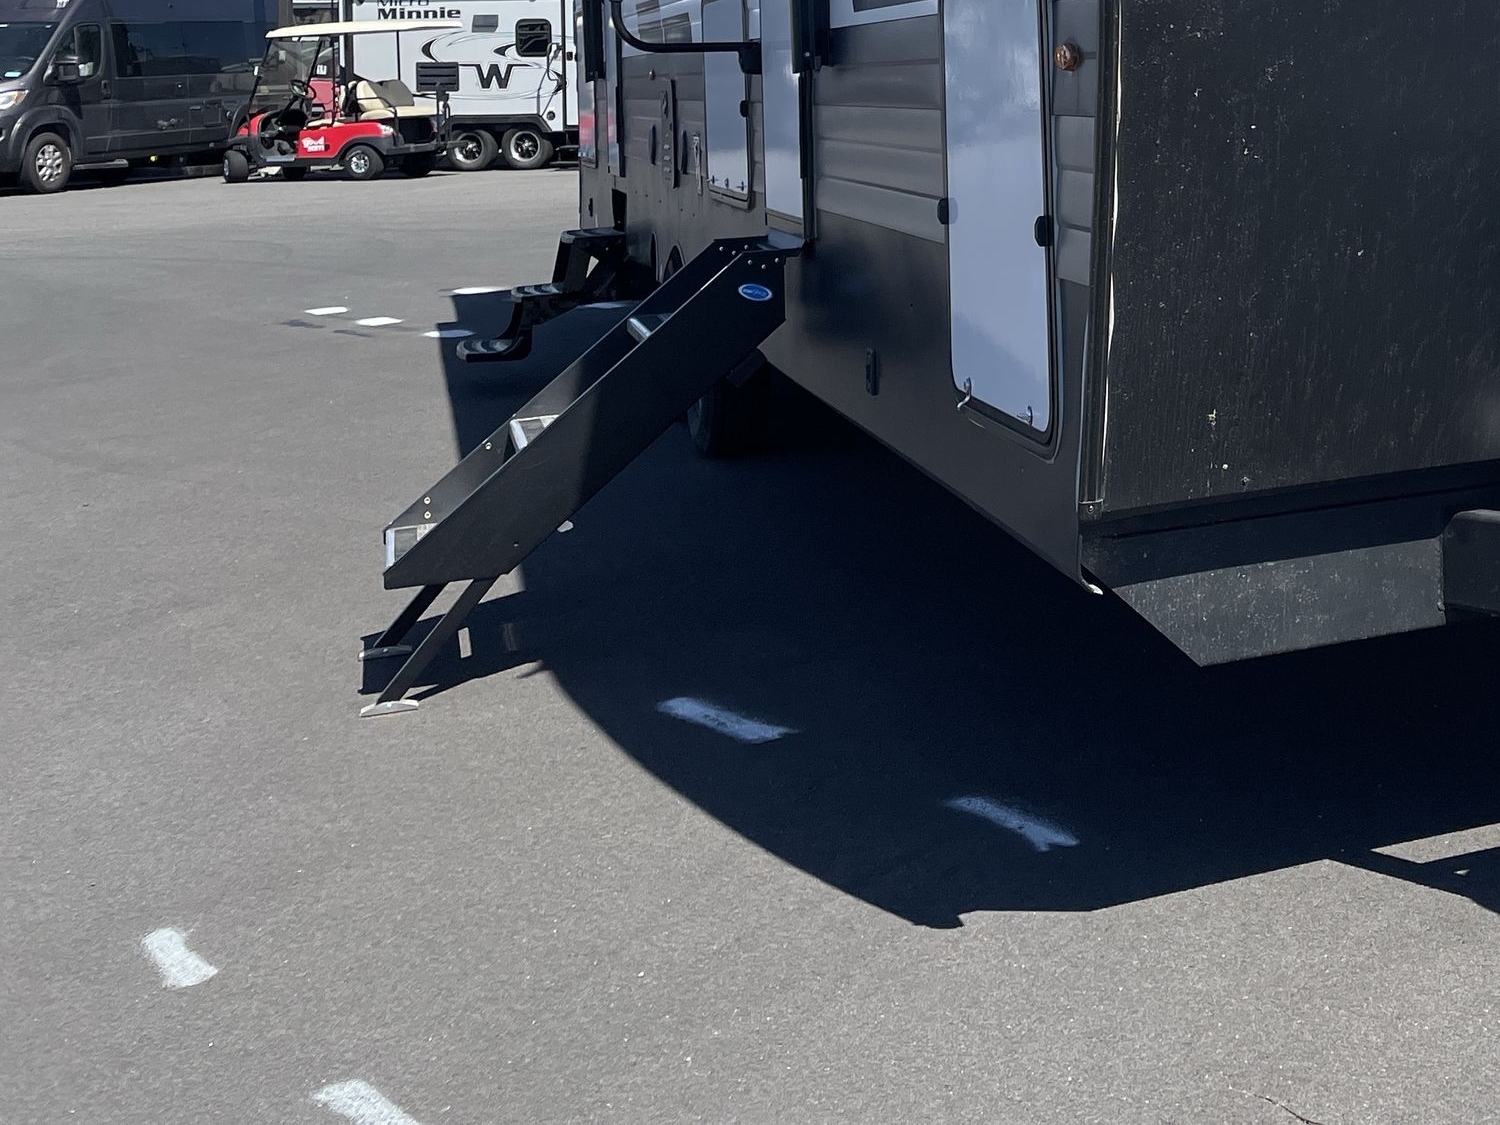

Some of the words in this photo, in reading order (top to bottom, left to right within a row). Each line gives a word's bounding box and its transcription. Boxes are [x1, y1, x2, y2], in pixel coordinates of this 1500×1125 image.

[377, 7, 461, 21] Minnie
[475, 63, 514, 90] W
[301, 136, 325, 148] good
